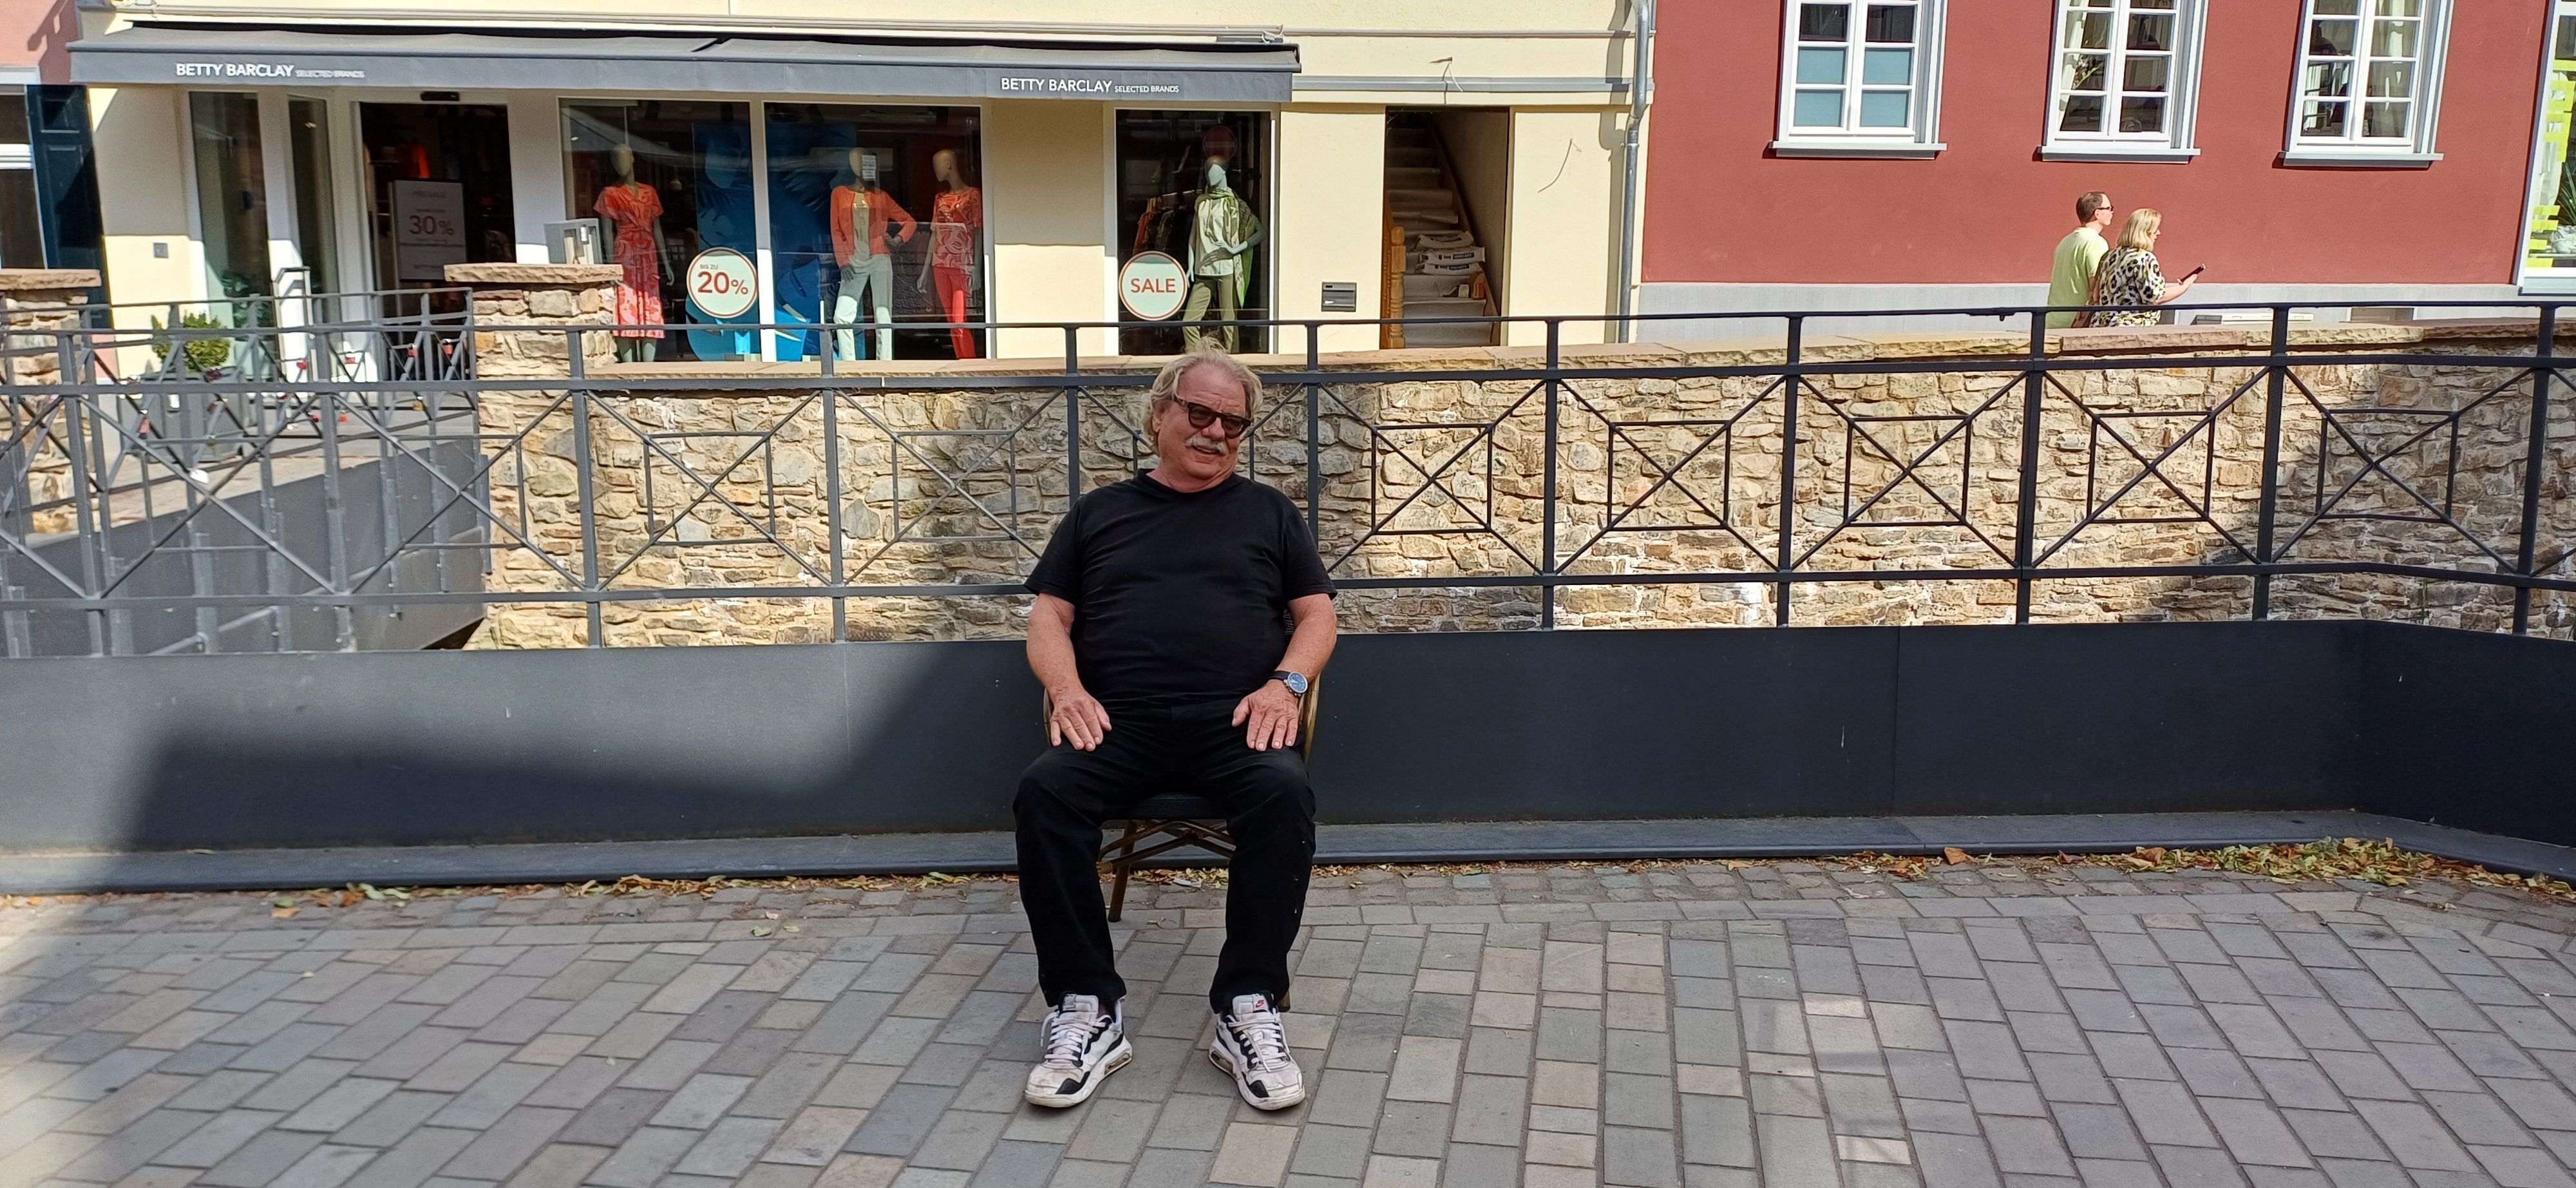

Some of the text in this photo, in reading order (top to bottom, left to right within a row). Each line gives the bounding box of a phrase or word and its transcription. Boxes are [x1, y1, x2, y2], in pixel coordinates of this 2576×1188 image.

[176, 63, 223, 76] BETTY
[226, 64, 294, 77] BARCLAY
[1001, 78, 1045, 91] BETTY
[1048, 79, 1112, 93] BARCLAY
[409, 215, 455, 235] 30%
[697, 271, 748, 294] 20%
[1130, 278, 1176, 293] SALE
